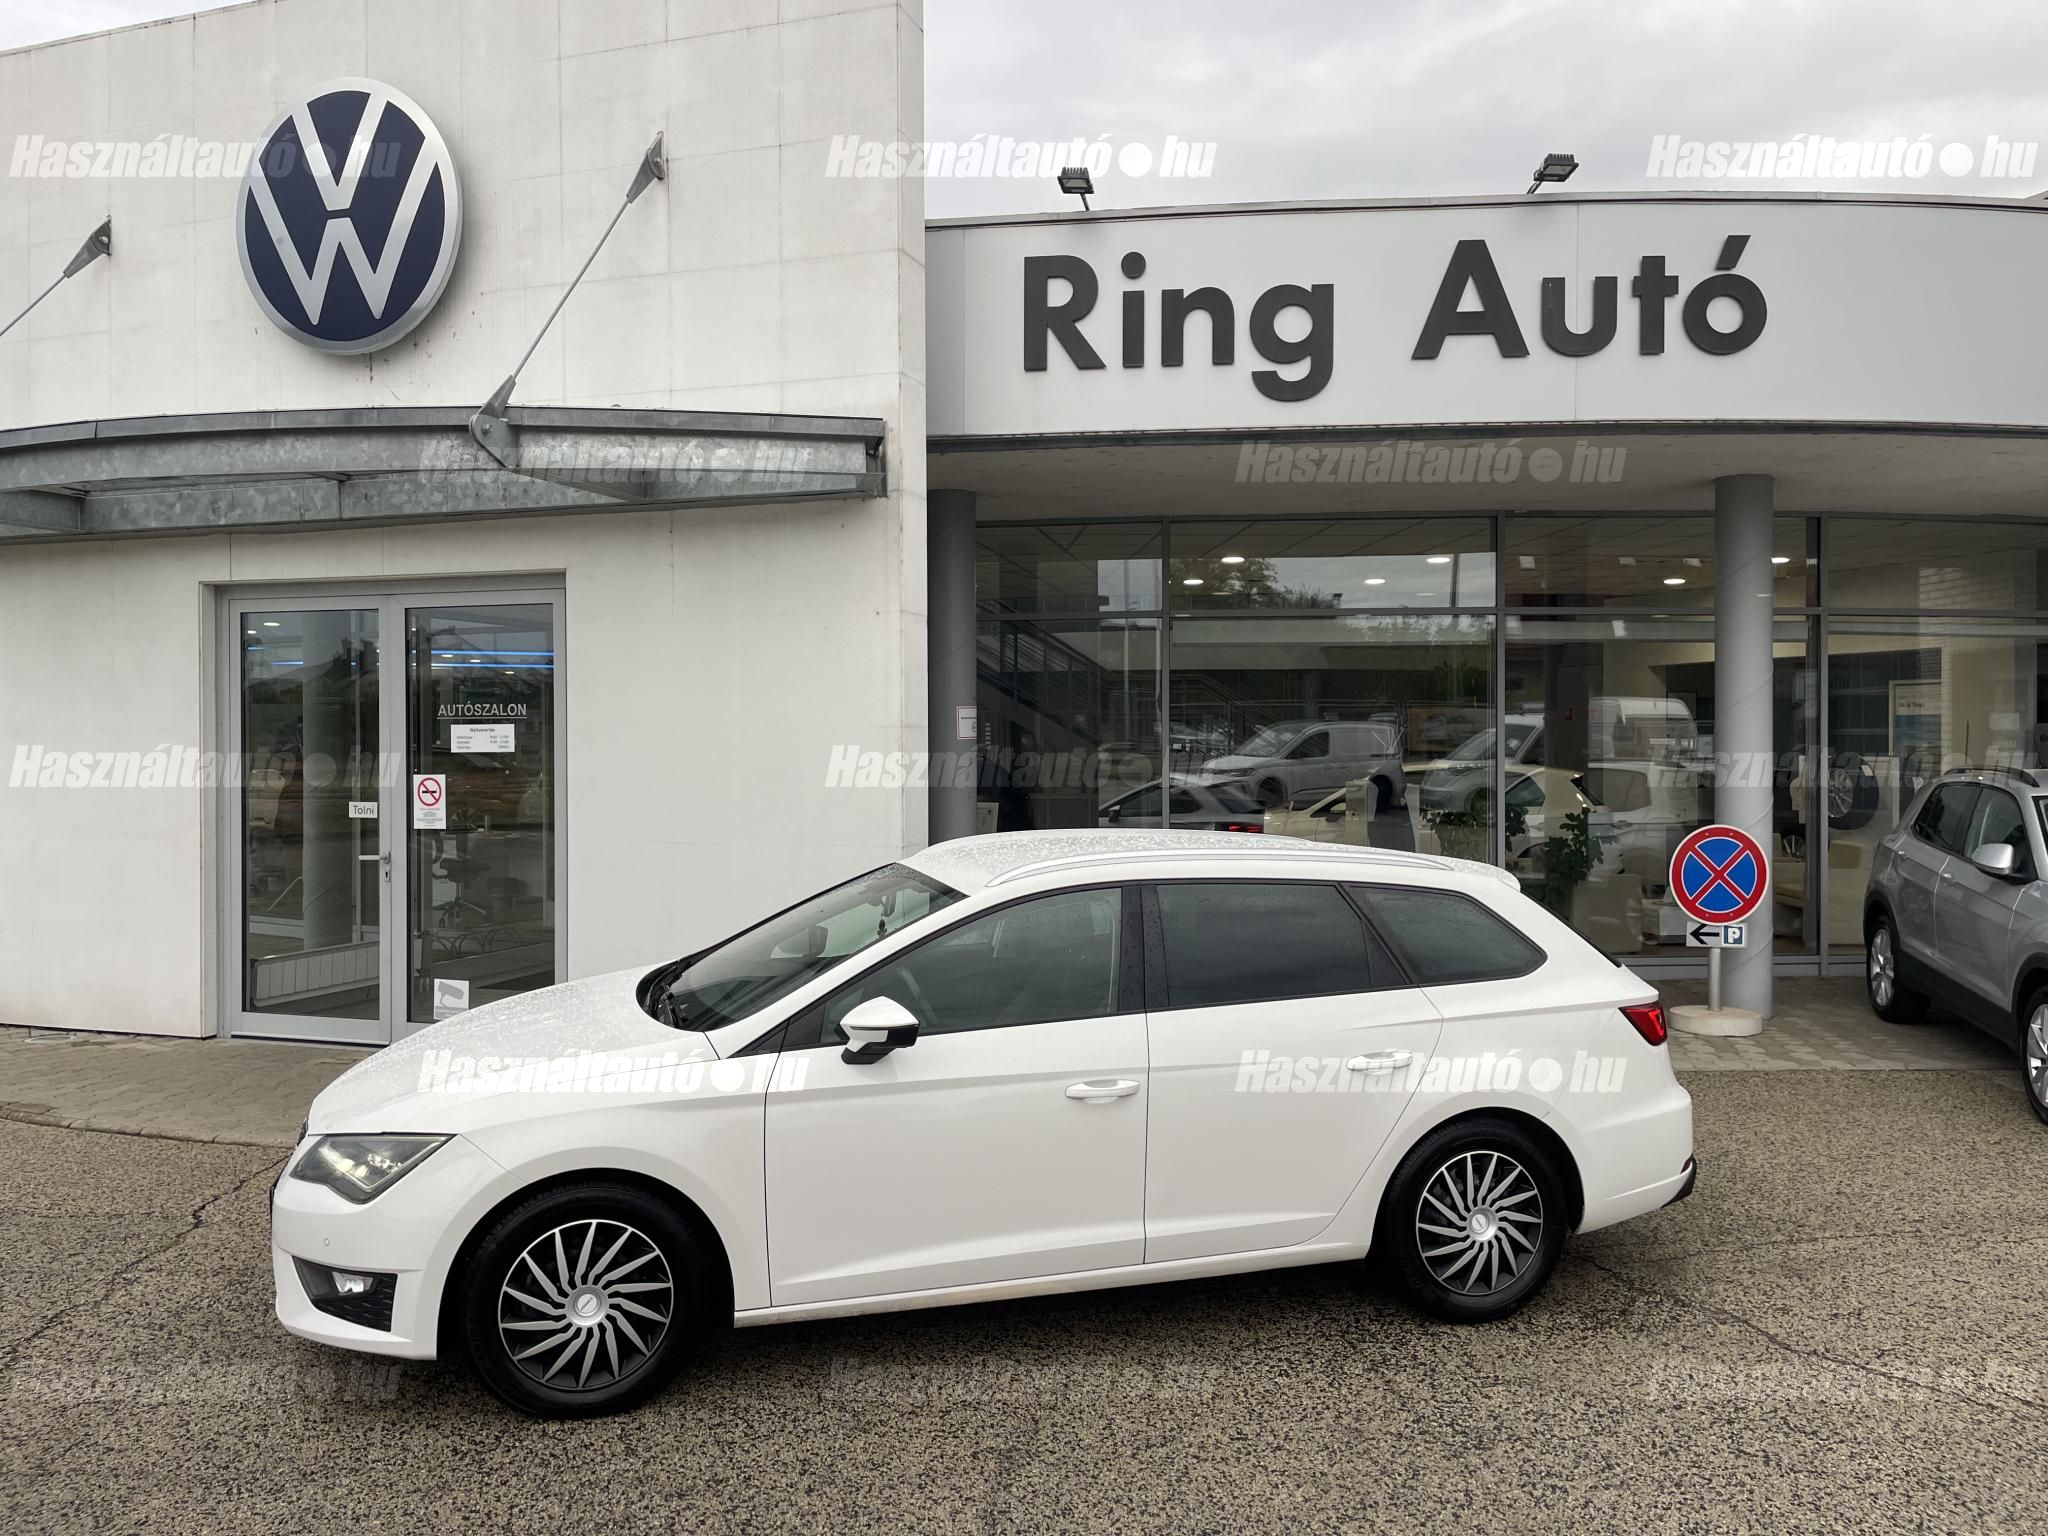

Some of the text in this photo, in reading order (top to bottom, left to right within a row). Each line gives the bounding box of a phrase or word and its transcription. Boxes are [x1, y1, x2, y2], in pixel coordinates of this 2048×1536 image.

[1024, 234, 1767, 403] Ring Autó
[438, 700, 527, 717] AUTÓSZALON
[352, 804, 374, 815] Tolni
[1727, 927, 1741, 944] P
